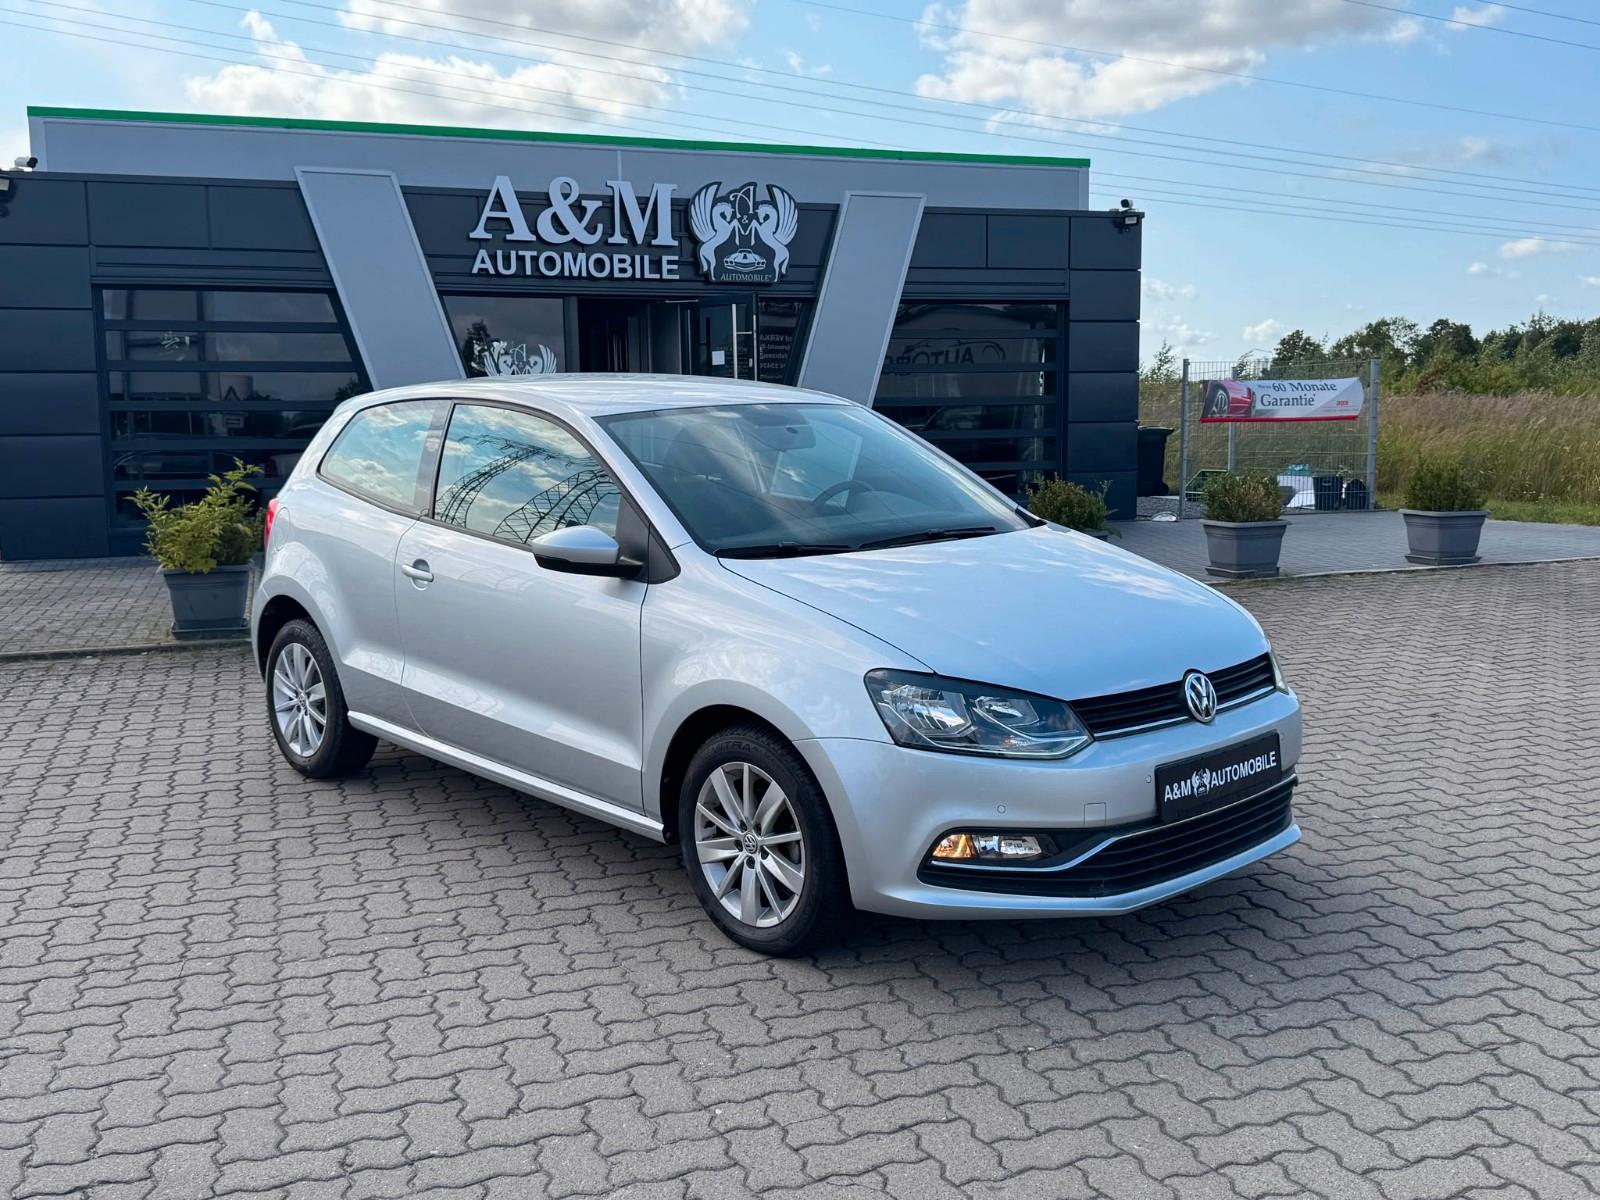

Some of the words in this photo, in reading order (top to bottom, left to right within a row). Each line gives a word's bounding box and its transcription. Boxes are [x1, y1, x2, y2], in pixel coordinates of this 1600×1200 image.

[469, 175, 679, 247] A&M
[472, 249, 680, 280] AUTOMOBILE
[1272, 382, 1287, 392] 60
[1288, 381, 1337, 392] Monate
[1164, 779, 1191, 802] A&M
[1210, 751, 1277, 788] AUTOMOBILE
